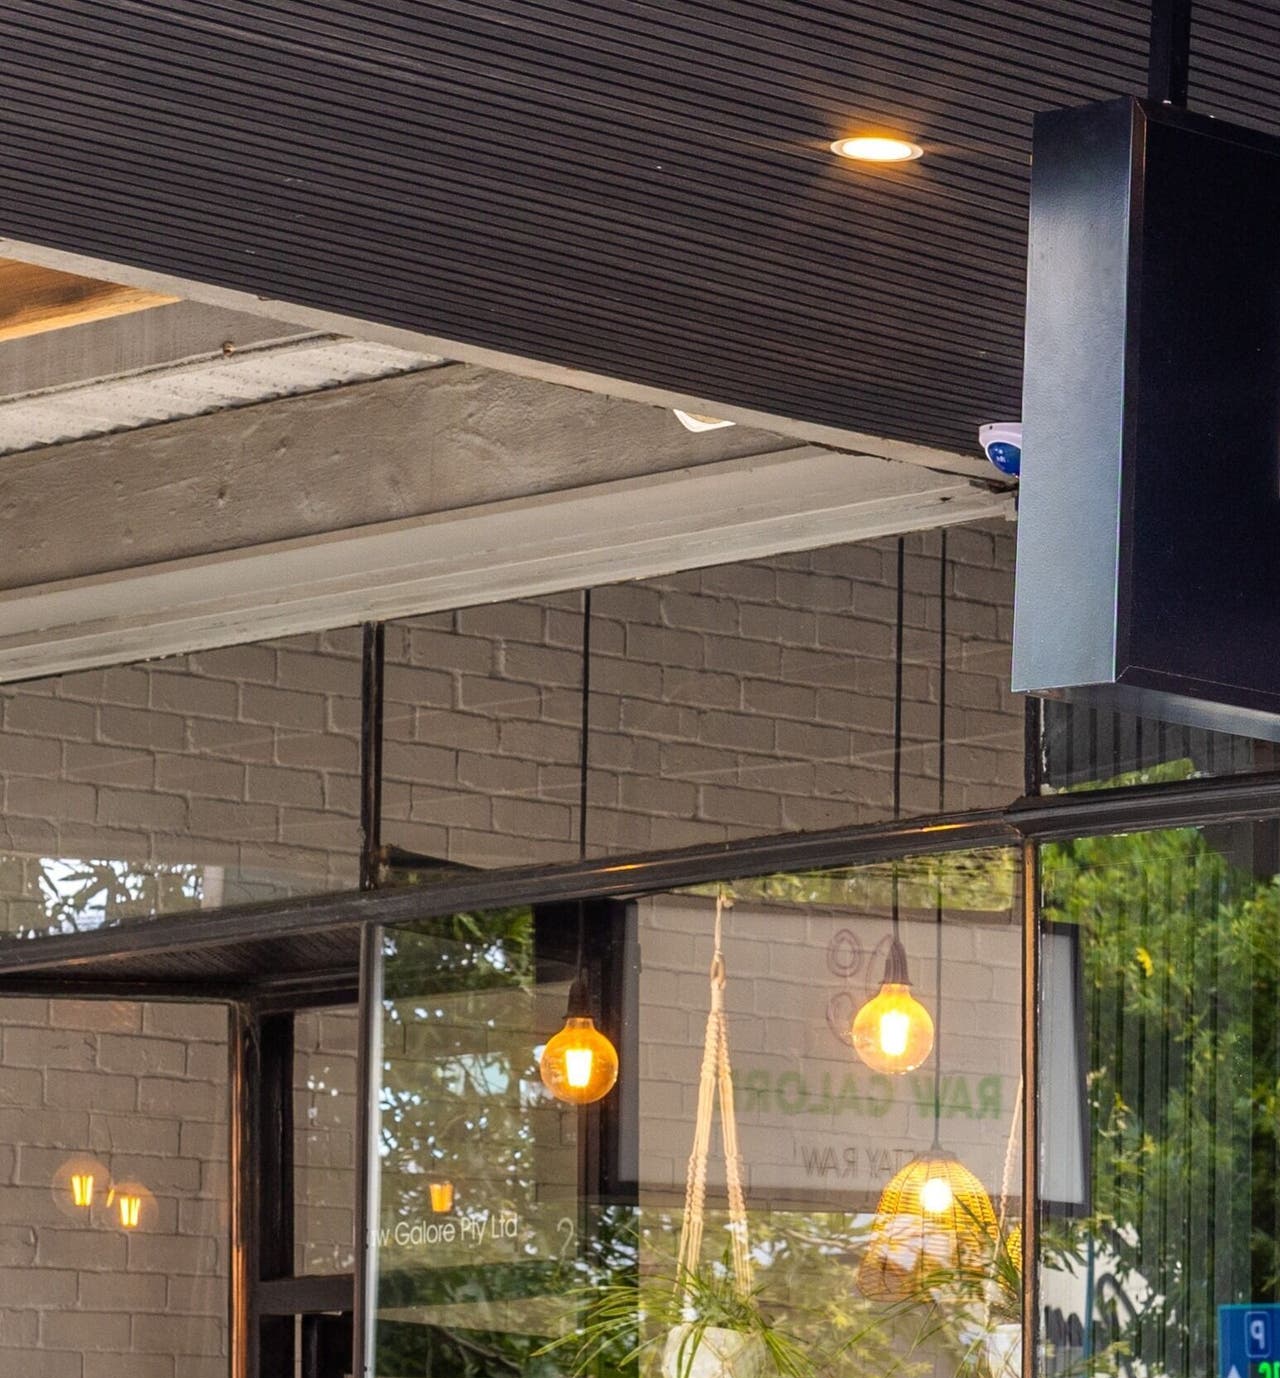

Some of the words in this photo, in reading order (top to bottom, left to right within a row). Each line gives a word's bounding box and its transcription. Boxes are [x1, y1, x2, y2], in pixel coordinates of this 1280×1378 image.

[395, 1219, 456, 1247] Galore
[460, 1218, 486, 1246] Pty
[491, 1213, 518, 1239] Ltd
